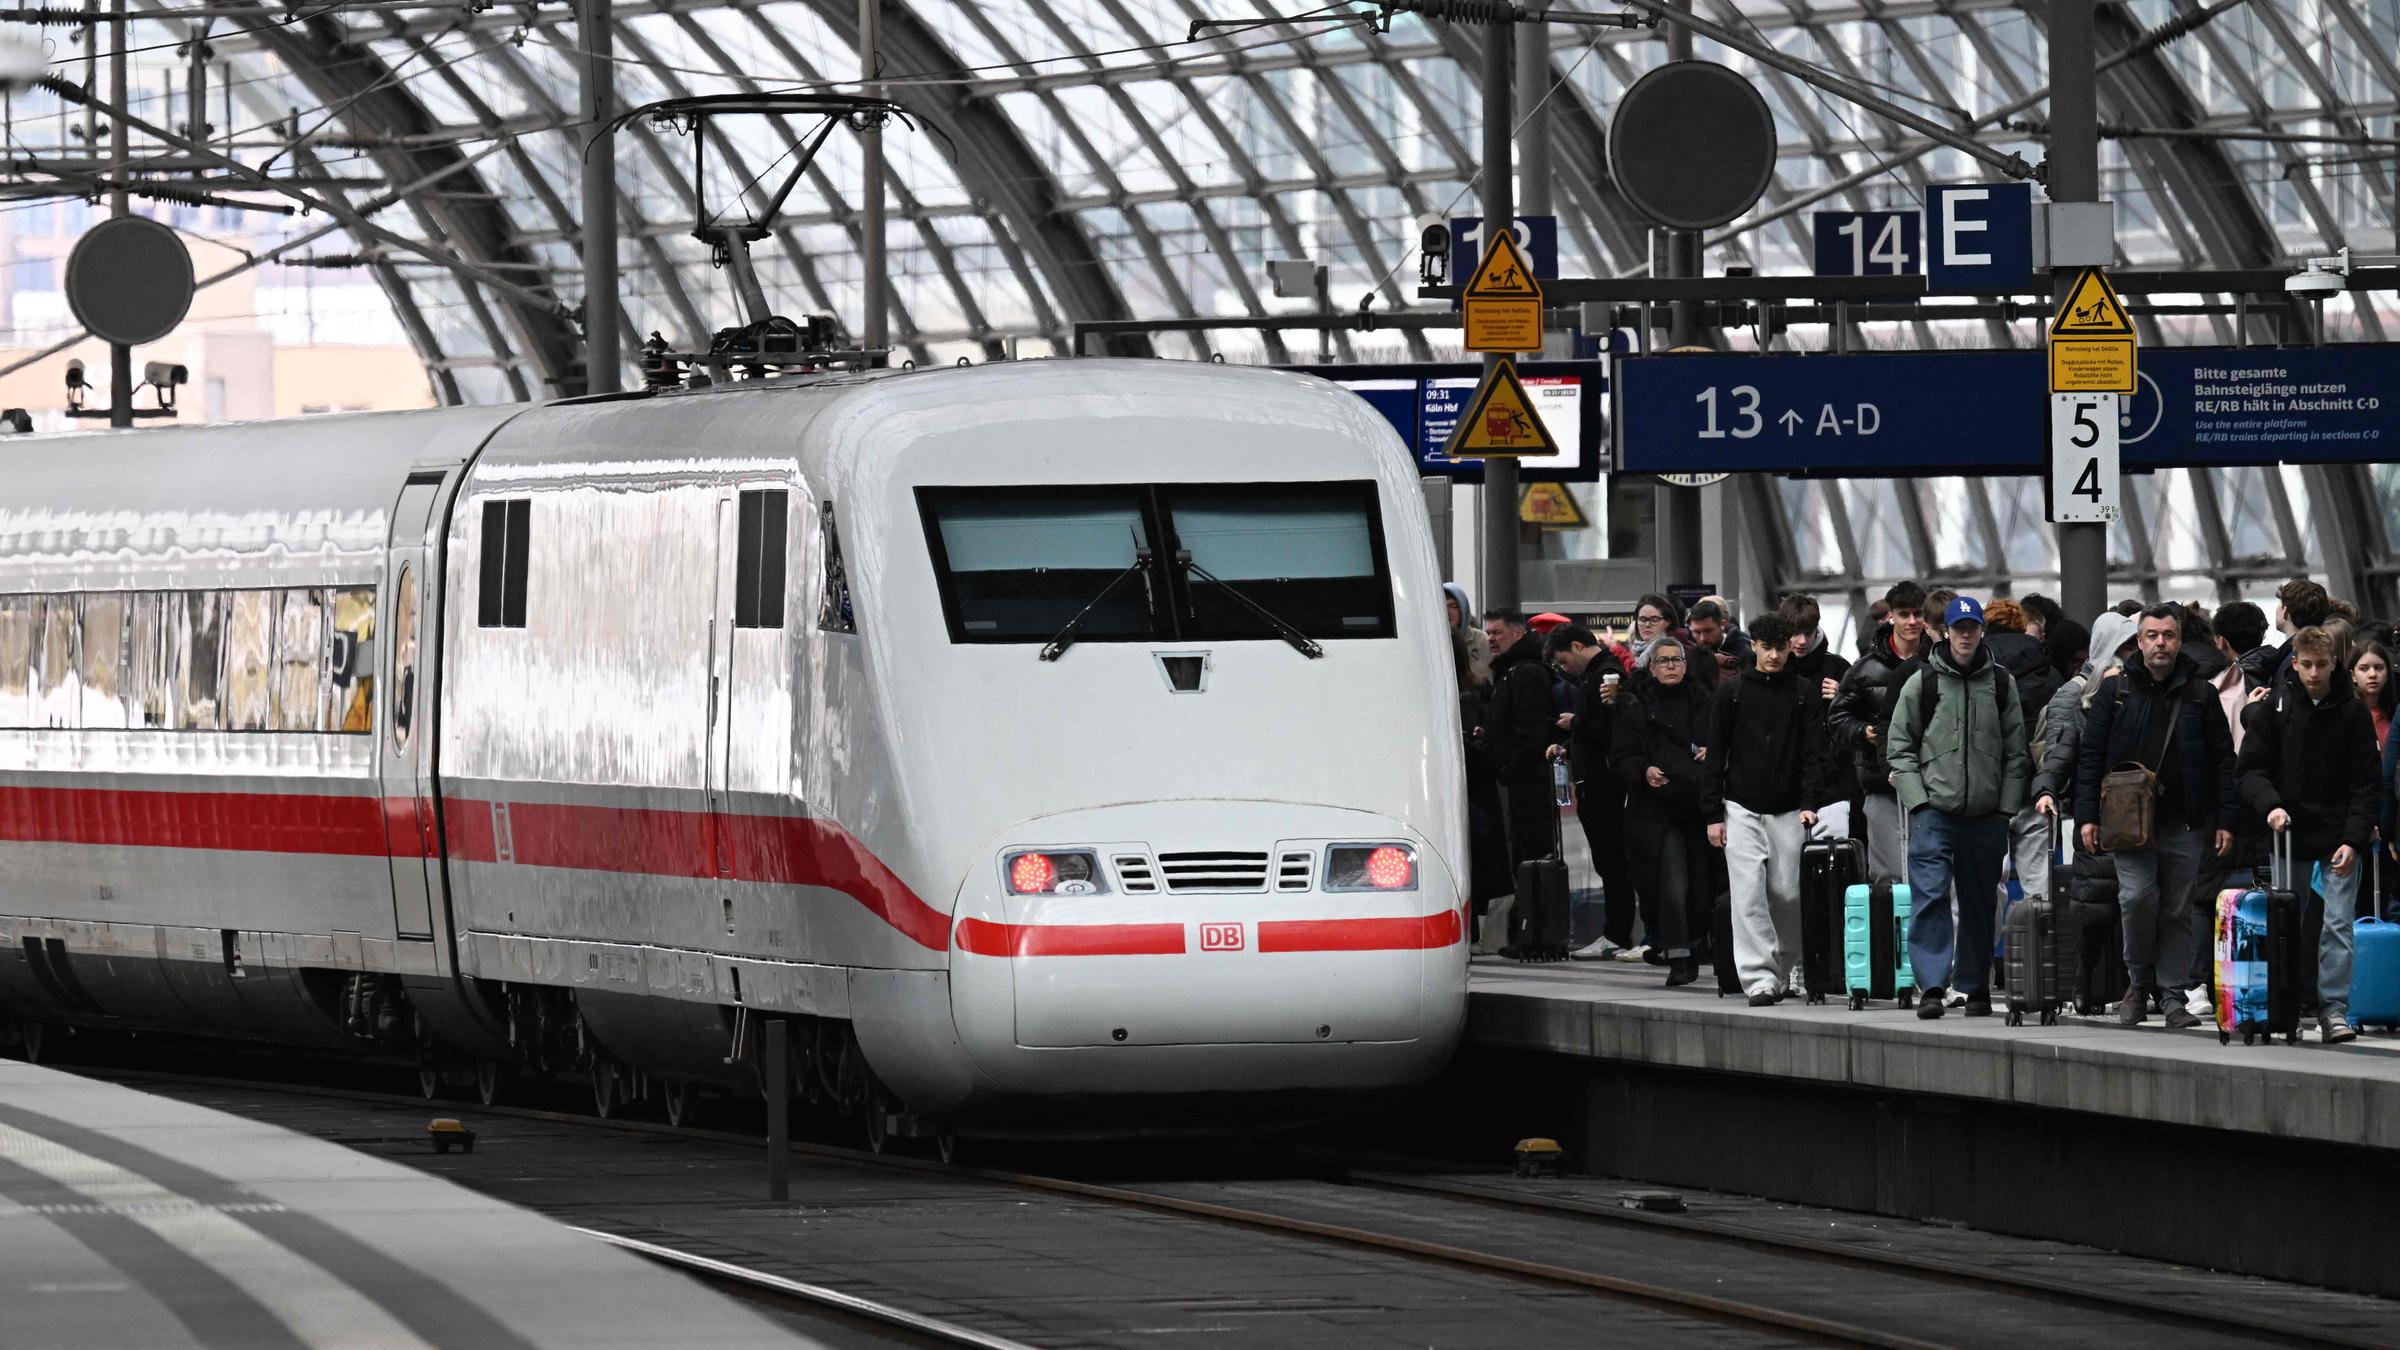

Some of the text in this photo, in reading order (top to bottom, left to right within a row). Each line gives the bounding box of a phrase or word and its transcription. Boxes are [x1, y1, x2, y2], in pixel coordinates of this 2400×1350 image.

[1941, 189, 1992, 266] E
[1838, 215, 1909, 276] 14
[2194, 367, 2288, 382] Bitte gesamte
[1426, 389, 1450, 400] 09:31
[2194, 383, 2347, 398] Bahnsteiglänge nutzen
[1425, 402, 1459, 412] Köln Hbf
[1695, 385, 1881, 439] 13 A-D
[2195, 398, 2380, 415] RE/RB hält in Abschnitt C-D
[2070, 402, 2100, 449] 5
[2195, 418, 2307, 431] Use the entire platform
[2195, 432, 2228, 443] RE/RB
[2230, 432, 2258, 442] trains
[2260, 431, 2309, 443] departing
[2310, 431, 2320, 441] in
[2321, 430, 2361, 440] sections
[2071, 457, 2103, 504] 4
[1959, 600, 1971, 613] LA
[1205, 926, 1240, 947] DB
